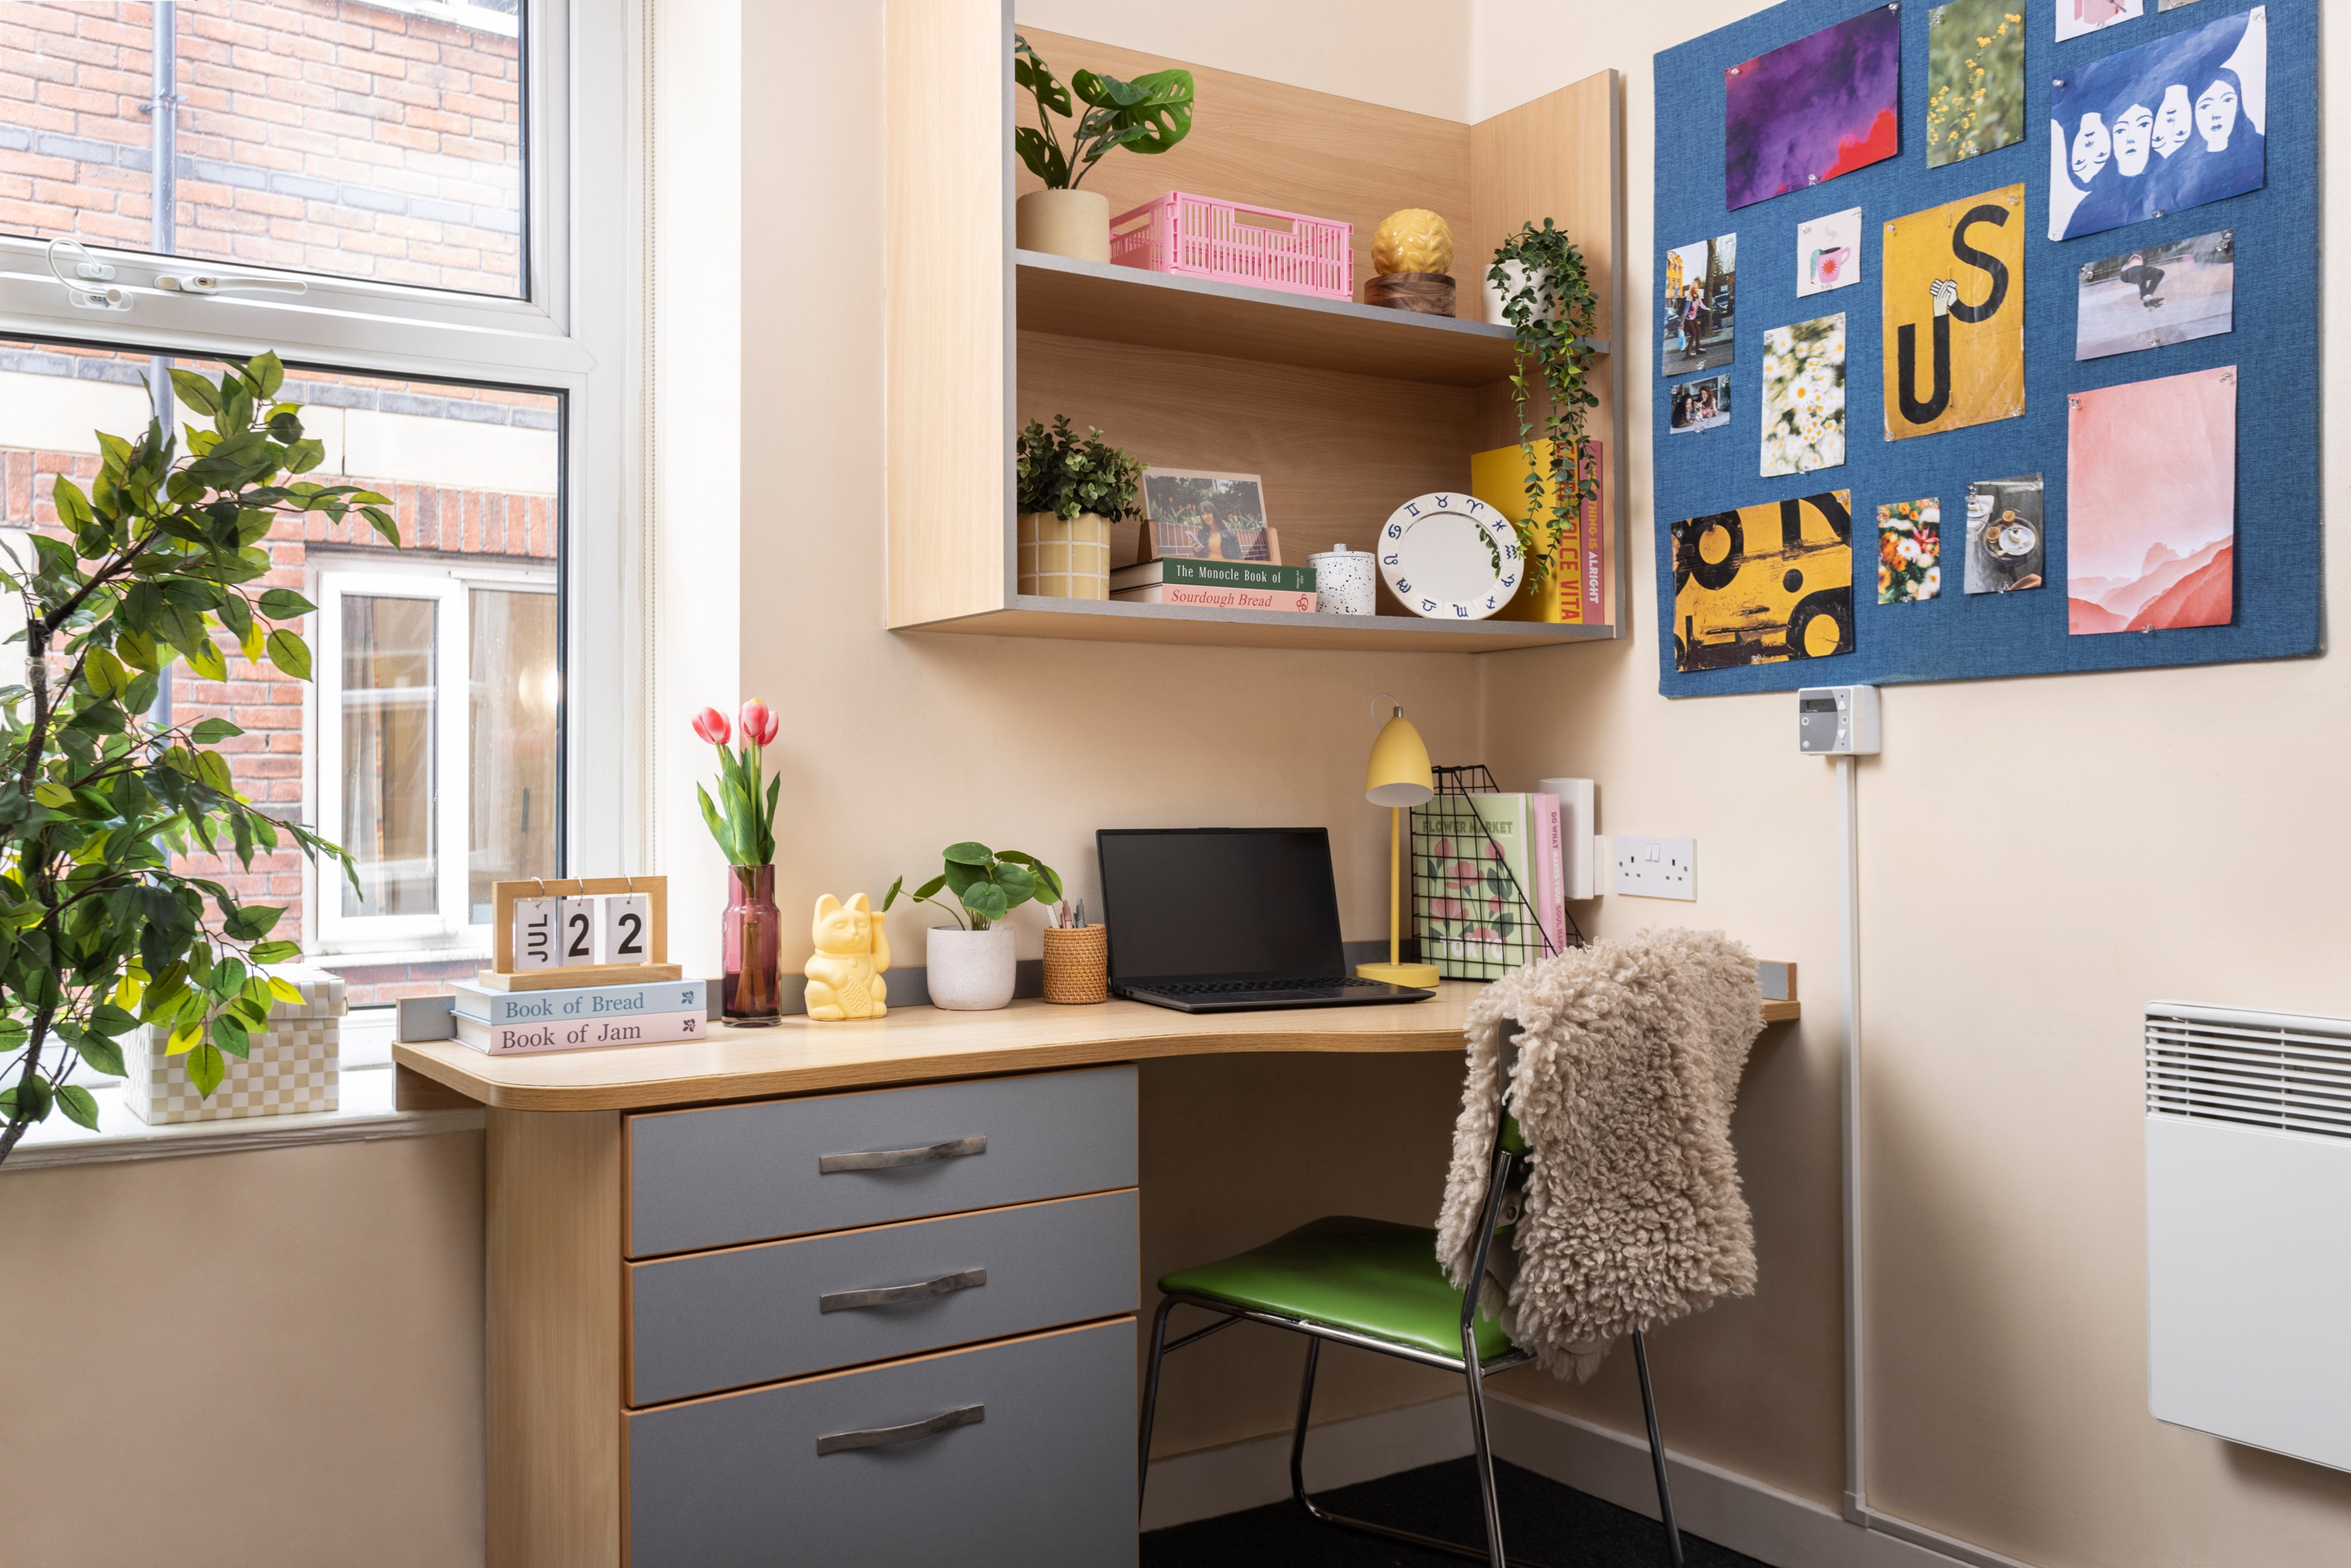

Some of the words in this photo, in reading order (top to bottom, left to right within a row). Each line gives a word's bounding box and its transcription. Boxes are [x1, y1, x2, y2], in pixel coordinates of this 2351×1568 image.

[1588, 538, 1597, 549] IS
[1177, 565, 1193, 577] The
[1199, 566, 1239, 580] Monocle
[1245, 570, 1267, 582] Book
[1272, 572, 1281, 583] of
[1589, 551, 1599, 604] ALRIGHT
[1171, 590, 1234, 607] Sourdough
[1238, 593, 1273, 607] Bread
[1561, 580, 1580, 620] VITA
[1422, 820, 1467, 833] FLOWER
[1469, 820, 1513, 833] MARKET
[1551, 812, 1558, 823] DO
[528, 913, 548, 962] JUL
[1440, 936, 1505, 959] TOKYO
[505, 999, 553, 1019] Book
[563, 996, 583, 1014] of
[592, 992, 645, 1012] Bread
[501, 1027, 555, 1049] Book
[567, 1024, 589, 1043] of
[598, 1023, 642, 1042] Jam
